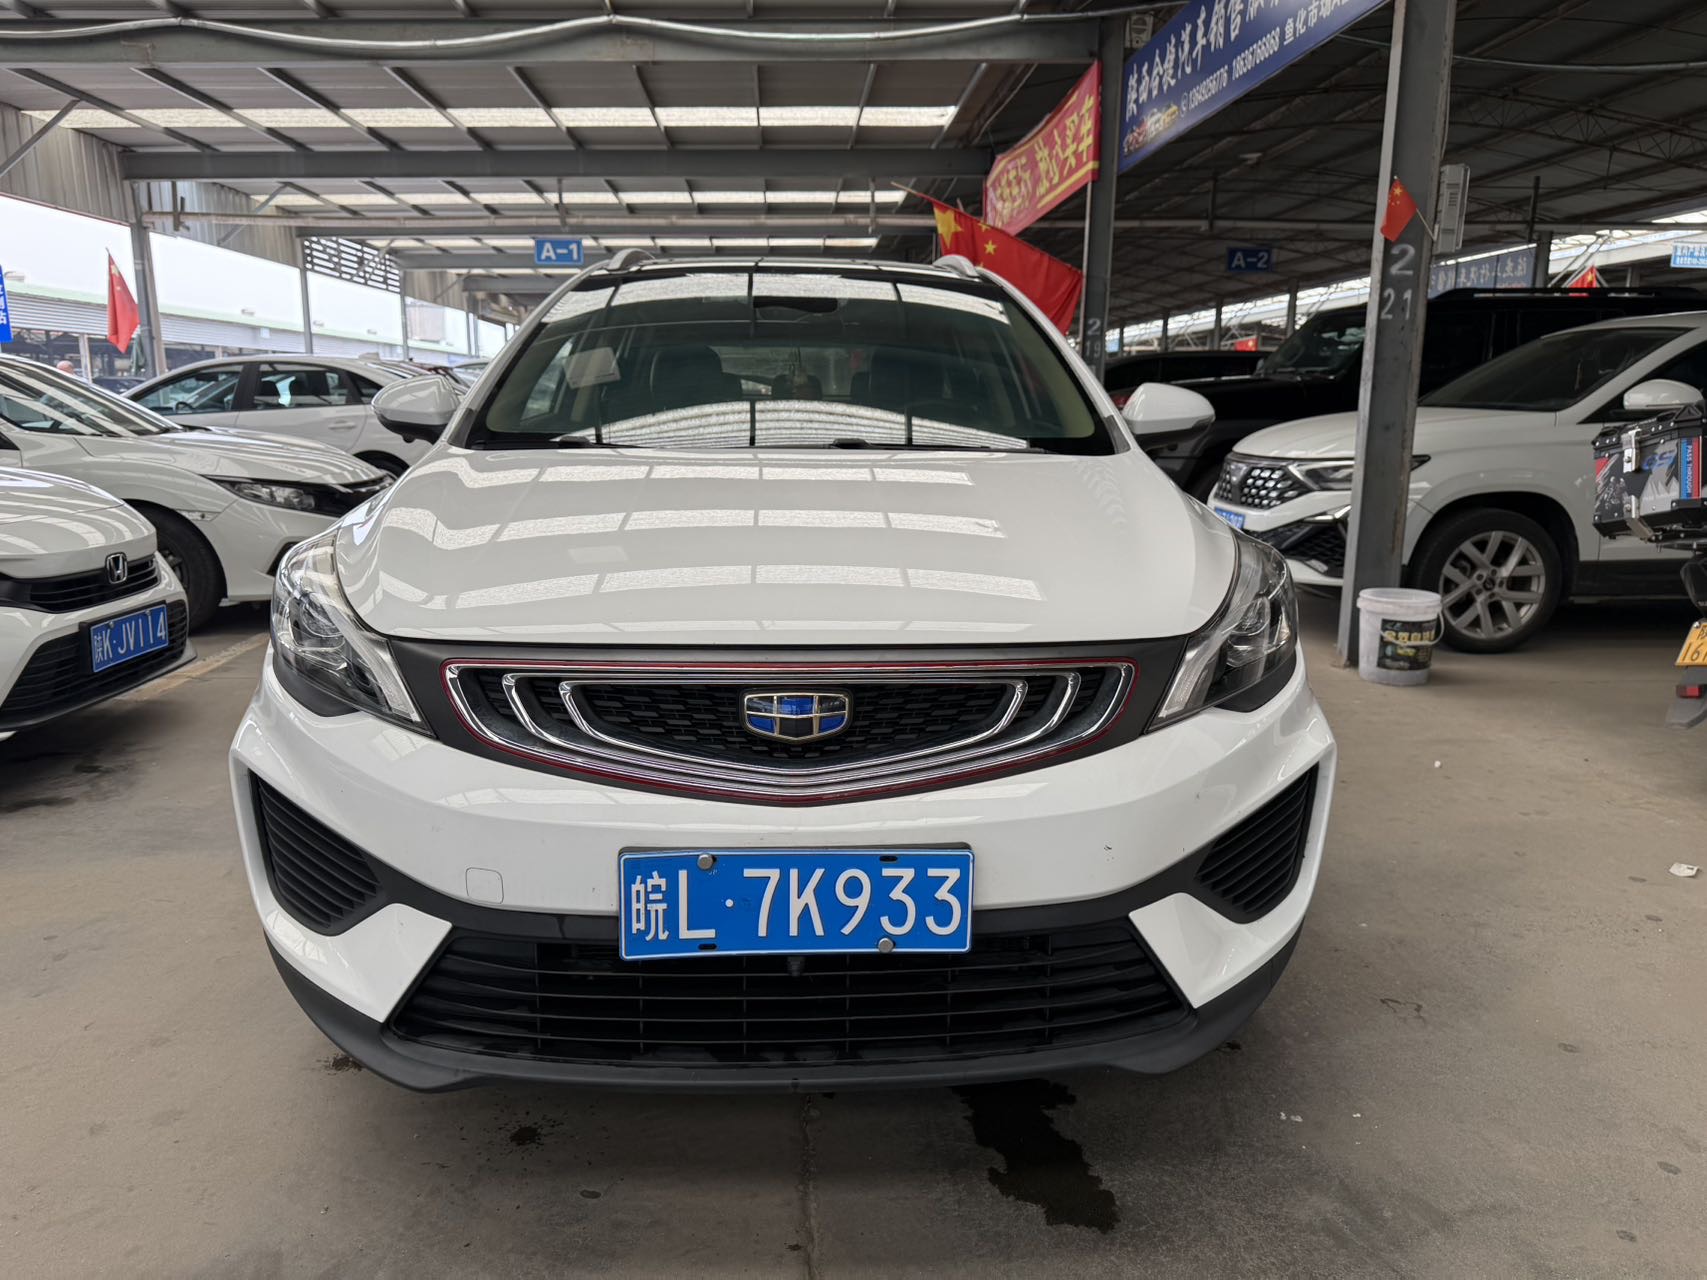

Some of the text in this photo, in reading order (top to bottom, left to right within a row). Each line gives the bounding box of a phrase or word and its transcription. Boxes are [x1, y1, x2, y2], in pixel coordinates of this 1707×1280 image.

[540, 241, 579, 260] A-1
[1231, 251, 1269, 269] A-2
[1390, 243, 1416, 276] 2
[1380, 287, 1413, 321] 21
[631, 867, 962, 942] 皖L·7K933
